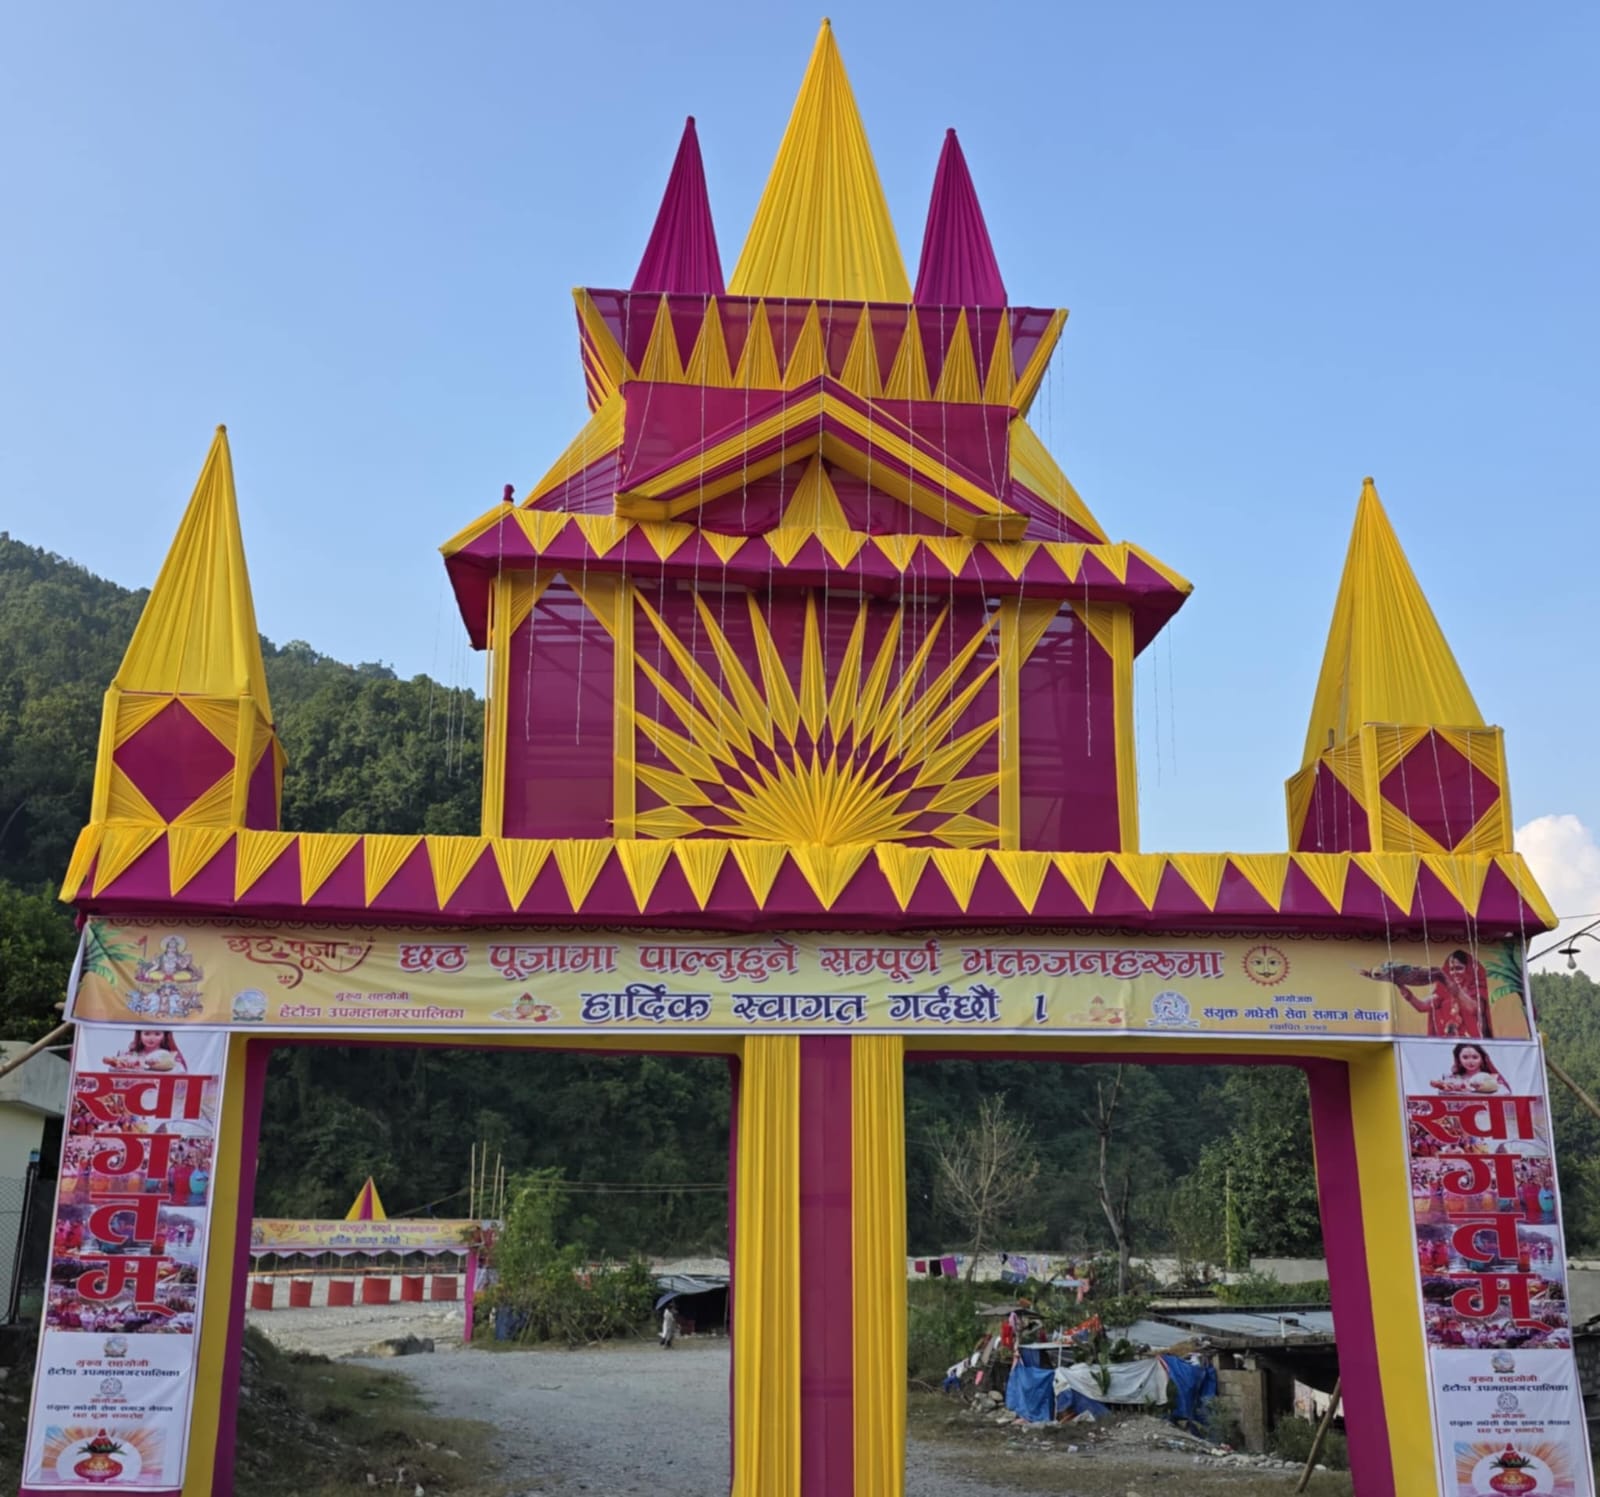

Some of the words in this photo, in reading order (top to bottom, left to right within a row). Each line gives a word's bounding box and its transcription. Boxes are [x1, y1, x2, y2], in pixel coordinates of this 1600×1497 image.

[401, 944, 466, 972] छठ
[490, 944, 617, 980] पूजामा
[639, 940, 796, 979] पाल्नुहुने
[820, 941, 941, 981] सम्पूर्ण
[328, 1006, 464, 1019] उपमहानगरपालिका
[581, 984, 711, 1022] हार्दिक
[734, 994, 866, 1023] स्वागत
[1285, 1007, 1306, 1019] सेवा
[1313, 1010, 1348, 1020] समाज
[1354, 1009, 1389, 1021] नेपाल
